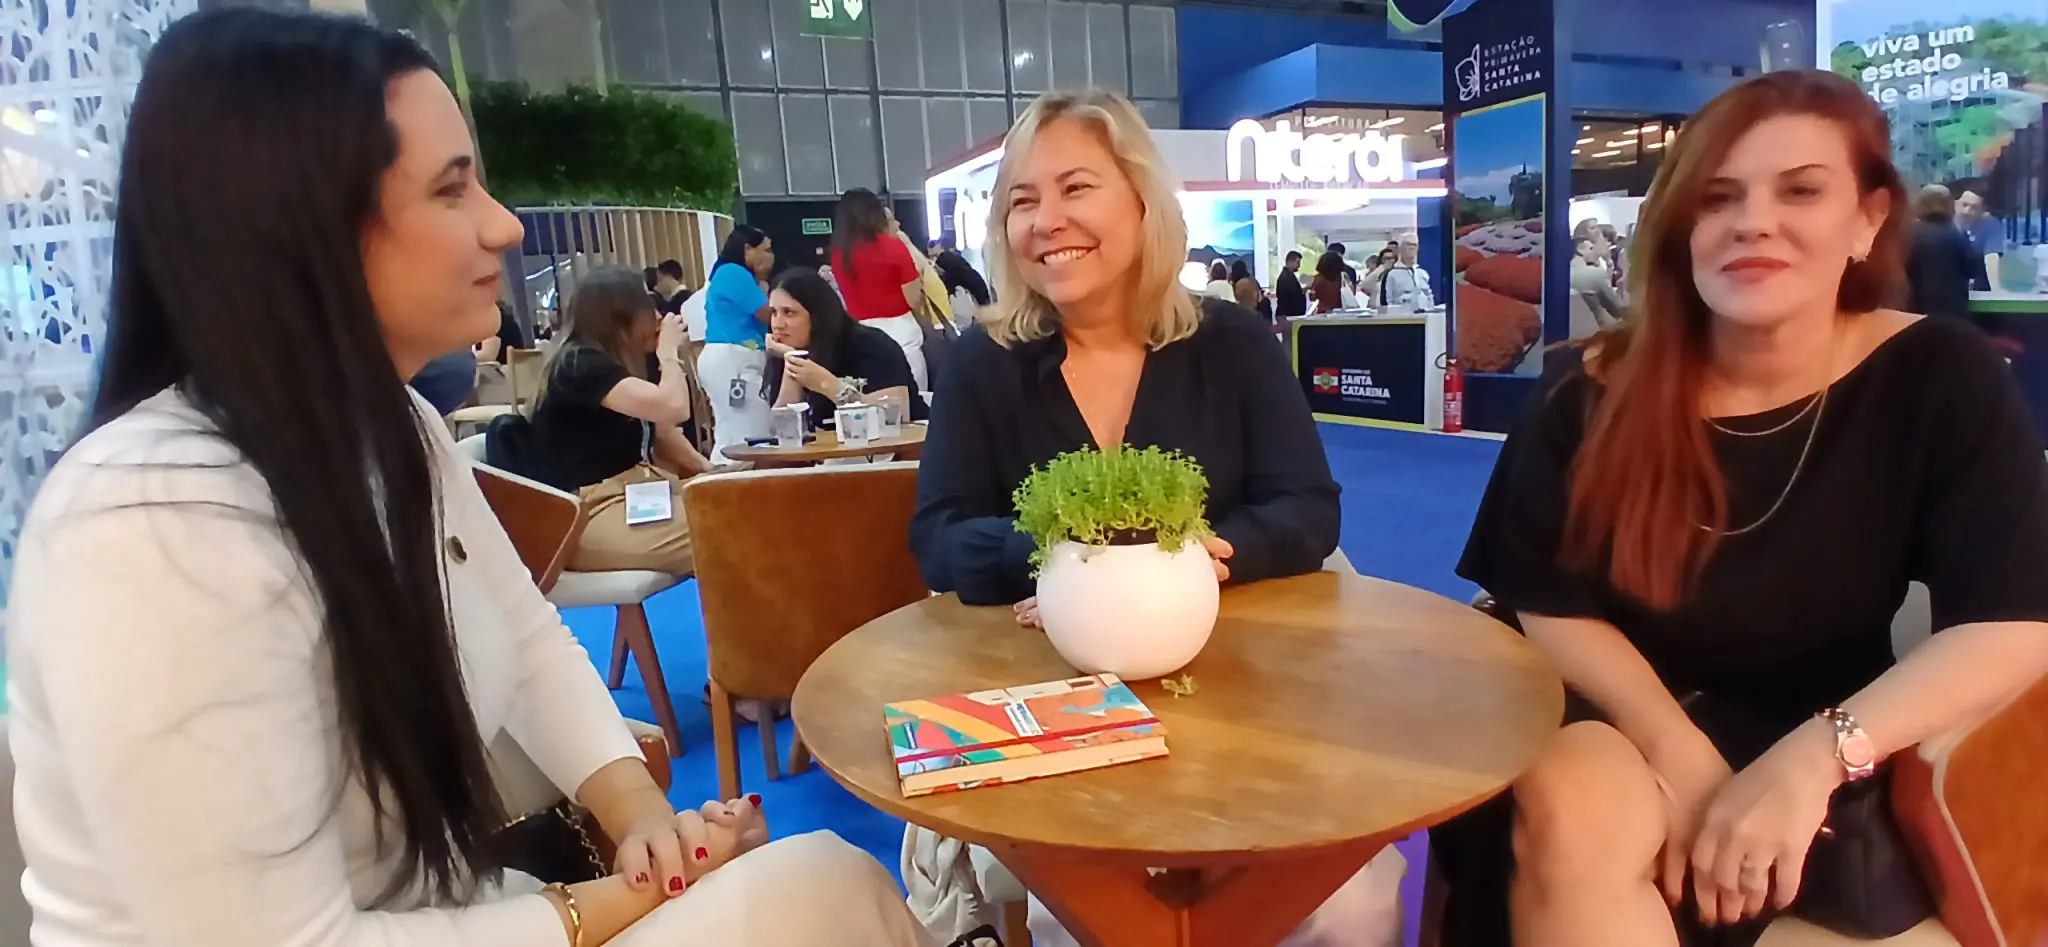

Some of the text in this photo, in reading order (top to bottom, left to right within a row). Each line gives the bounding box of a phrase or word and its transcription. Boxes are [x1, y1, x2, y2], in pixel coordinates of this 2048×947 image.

[1484, 35, 1535, 57] ESTAÇÃO
[1861, 25, 1975, 58] viva um
[1484, 47, 1541, 68] PRIMAVERA
[1861, 48, 1962, 82] estado
[1484, 64, 1520, 80] SANTA
[1484, 70, 1541, 92] CATARINA
[1906, 68, 2009, 101] alegria
[1341, 374, 1373, 386] SANTA
[1341, 385, 1391, 399] CATARINA
